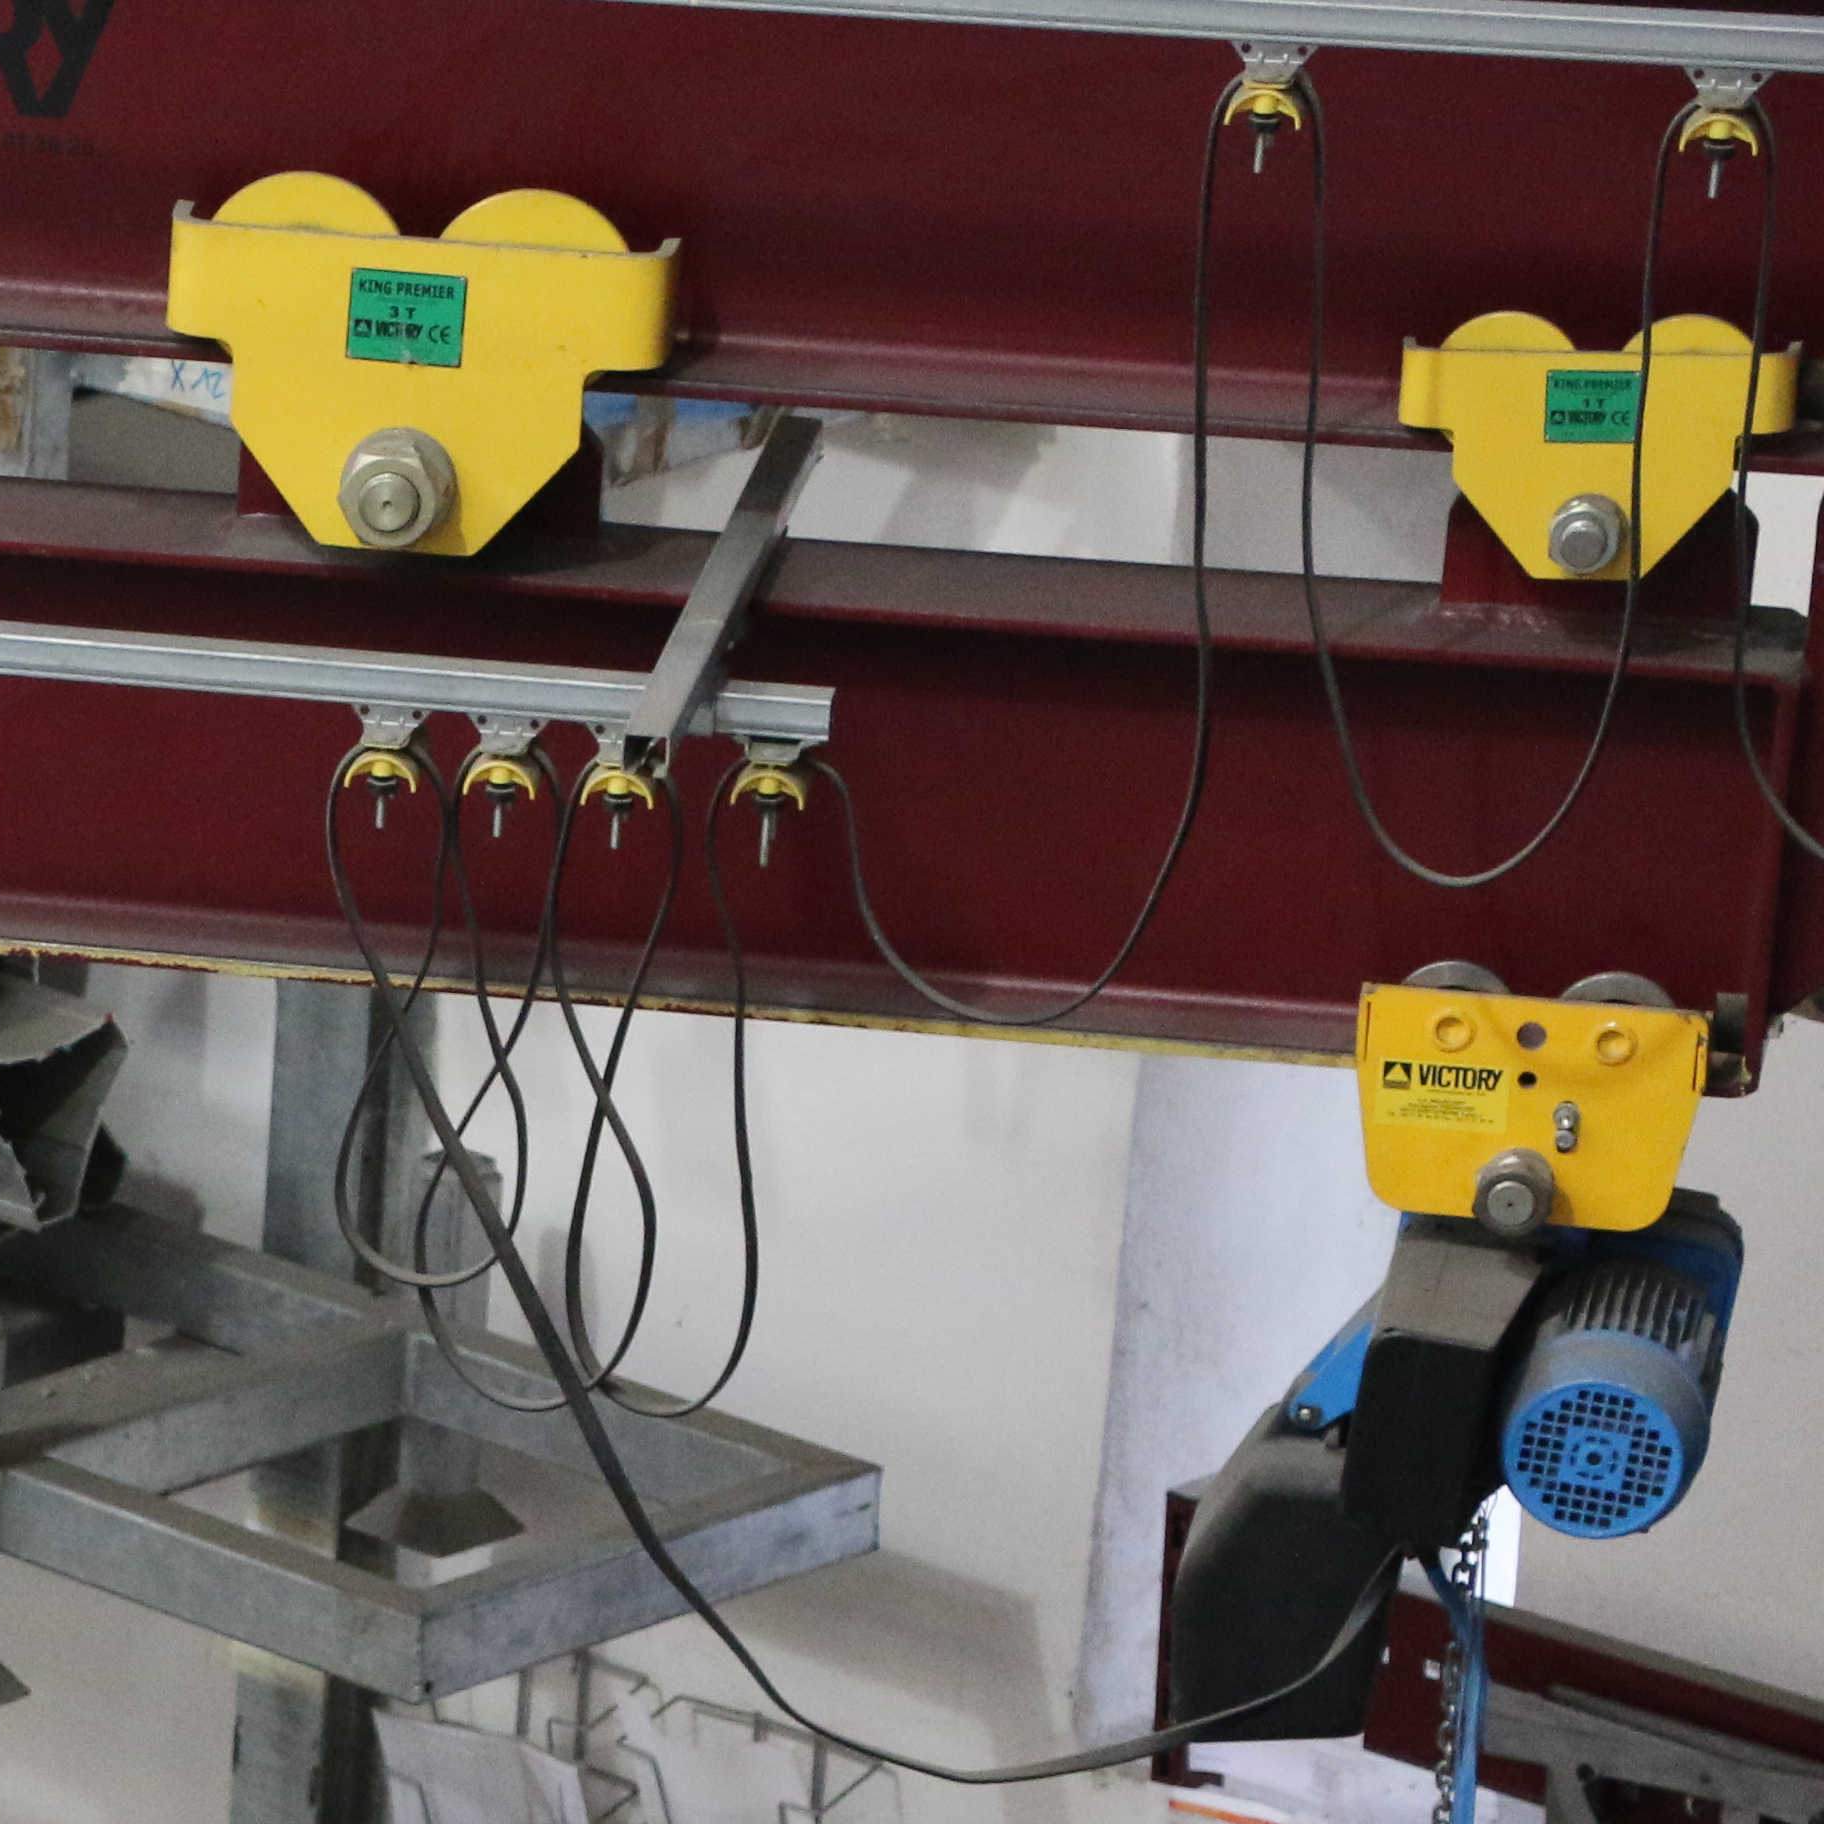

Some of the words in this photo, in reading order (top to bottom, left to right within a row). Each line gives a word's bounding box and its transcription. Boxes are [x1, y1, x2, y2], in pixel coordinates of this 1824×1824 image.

[358, 279, 393, 295] KING
[396, 283, 455, 300] PREMIER
[388, 306, 399, 318] 3
[405, 307, 417, 319] T
[1418, 1063, 1504, 1091] VICTORY
